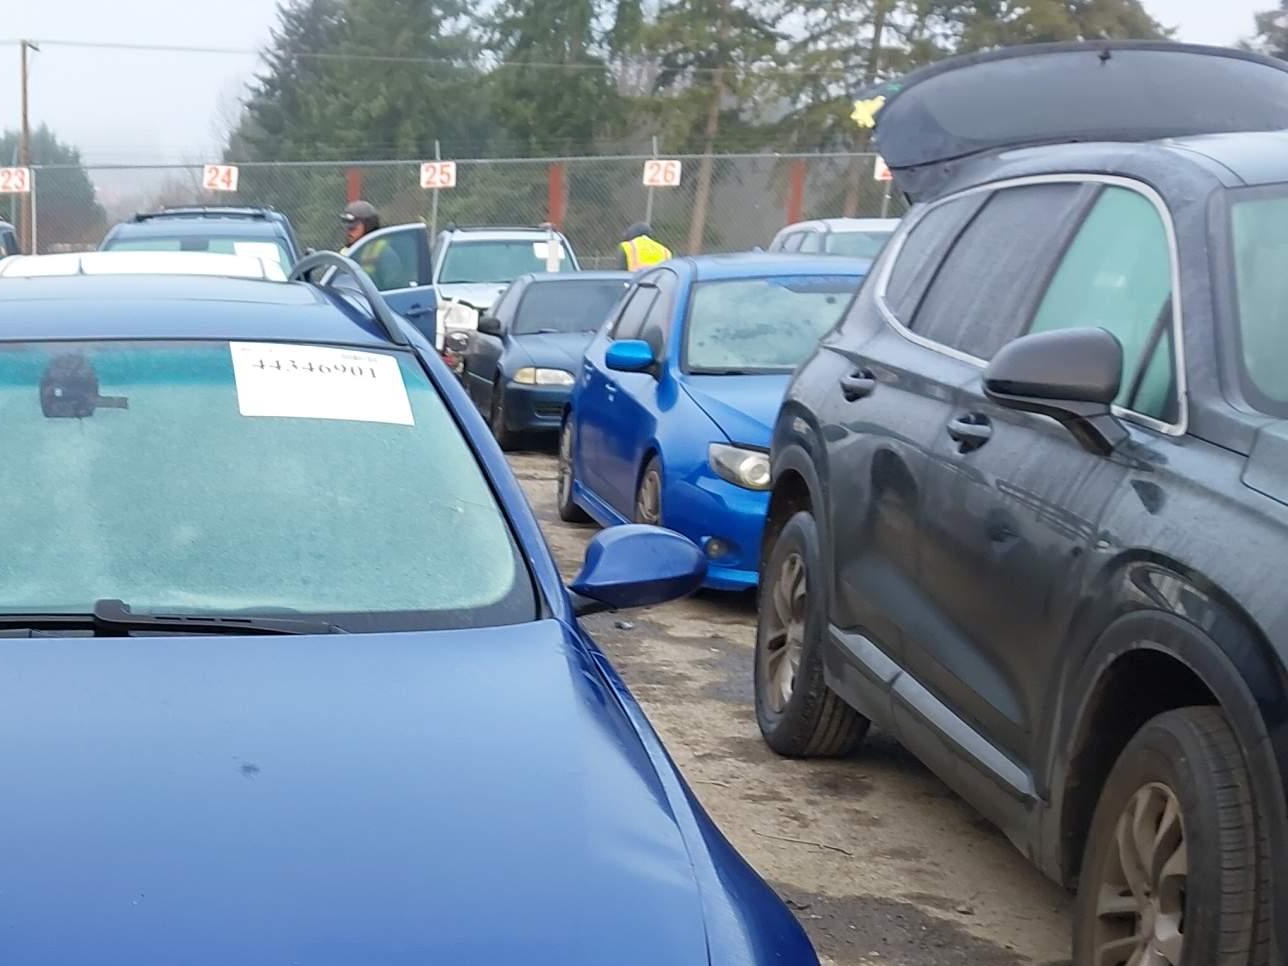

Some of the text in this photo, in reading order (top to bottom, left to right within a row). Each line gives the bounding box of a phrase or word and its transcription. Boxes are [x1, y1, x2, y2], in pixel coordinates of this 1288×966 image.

[0, 170, 26, 191] 23
[207, 166, 233, 188] 24
[424, 163, 451, 186] 25
[648, 162, 677, 184] 26
